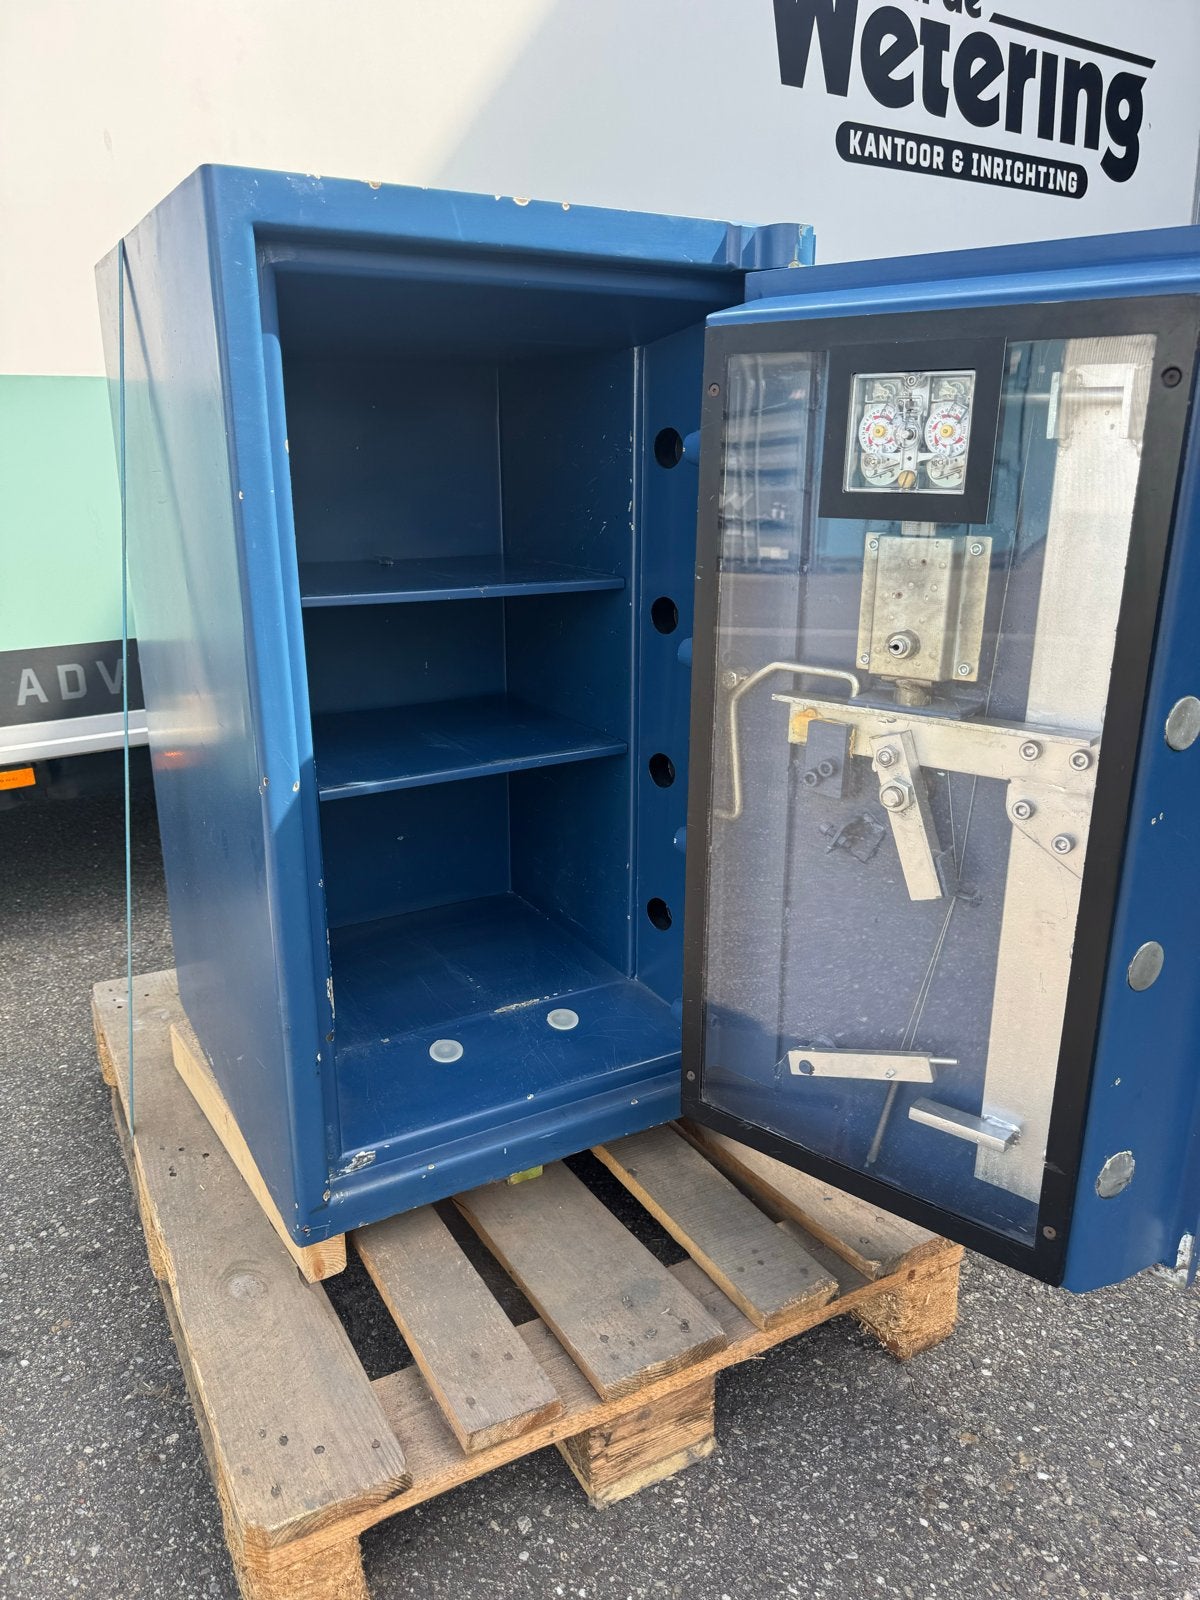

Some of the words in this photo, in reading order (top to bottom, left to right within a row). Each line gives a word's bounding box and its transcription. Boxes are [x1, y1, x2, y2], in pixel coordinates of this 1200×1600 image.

[773, 0, 1147, 183] Wetering
[849, 129, 945, 170] KANTOOR
[952, 149, 964, 173] &
[971, 152, 1078, 193] INRICHTING
